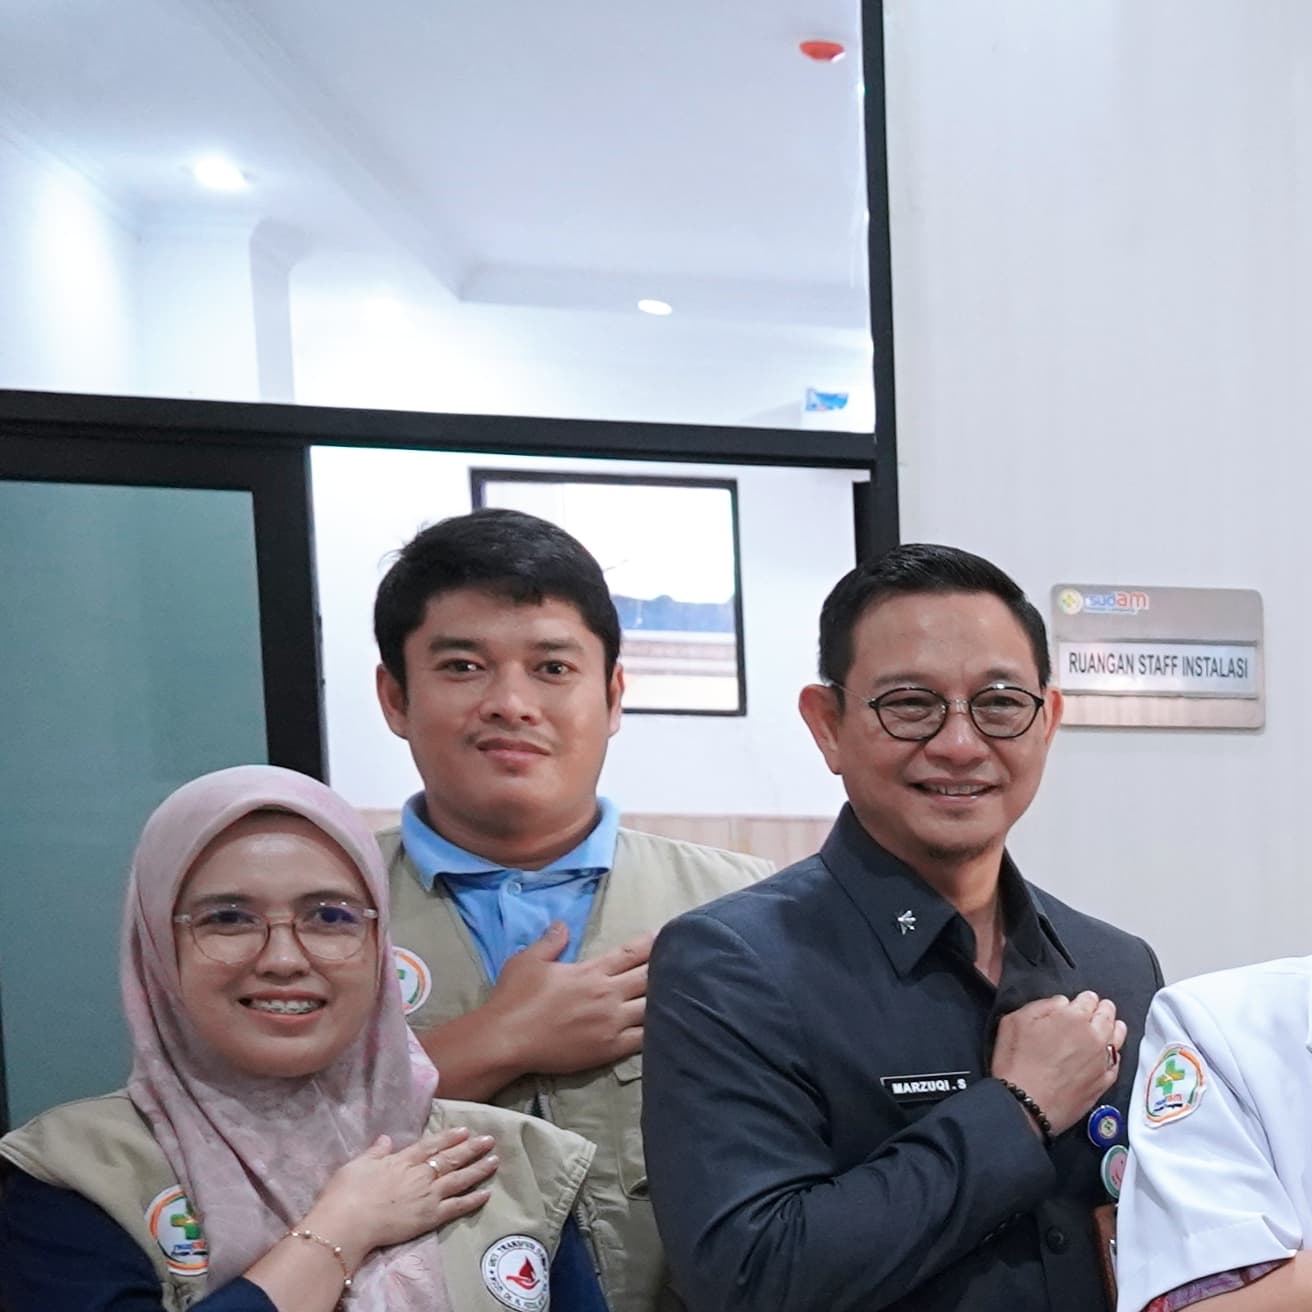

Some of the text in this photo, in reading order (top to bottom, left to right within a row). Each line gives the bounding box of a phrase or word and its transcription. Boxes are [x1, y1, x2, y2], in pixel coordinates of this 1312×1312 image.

[1069, 652, 1248, 679] RUANGAN STAFF INSTALASI
